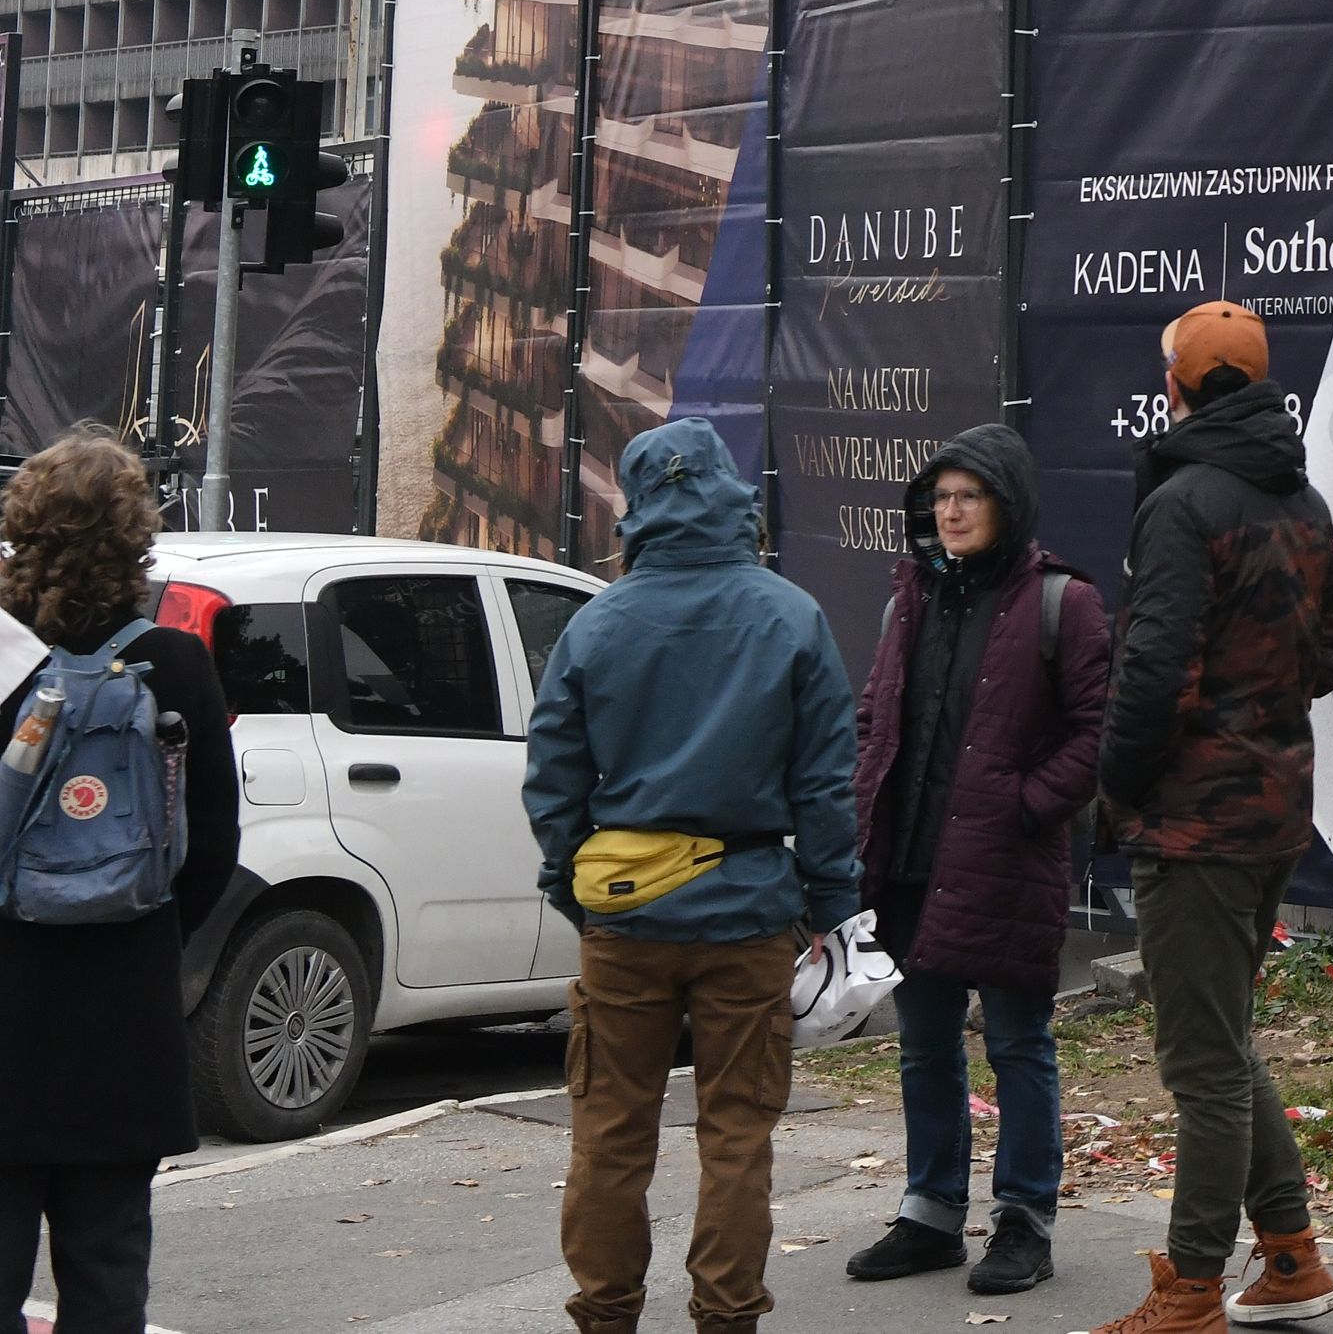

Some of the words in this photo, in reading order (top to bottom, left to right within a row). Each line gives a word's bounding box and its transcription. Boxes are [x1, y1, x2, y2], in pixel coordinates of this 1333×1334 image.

[1080, 171, 1202, 203] EKSKLUZIVNI
[1205, 164, 1321, 196] ZASTUPNIK
[809, 204, 964, 264] DANUBE
[818, 239, 951, 321] Riverside
[1074, 249, 1205, 295] KADENA
[828, 366, 858, 409] NA
[862, 367, 931, 412] MESTU
[1111, 393, 1170, 438] +38
[795, 434, 944, 483] VANVREMENS
[839, 505, 913, 554] SUSRET
